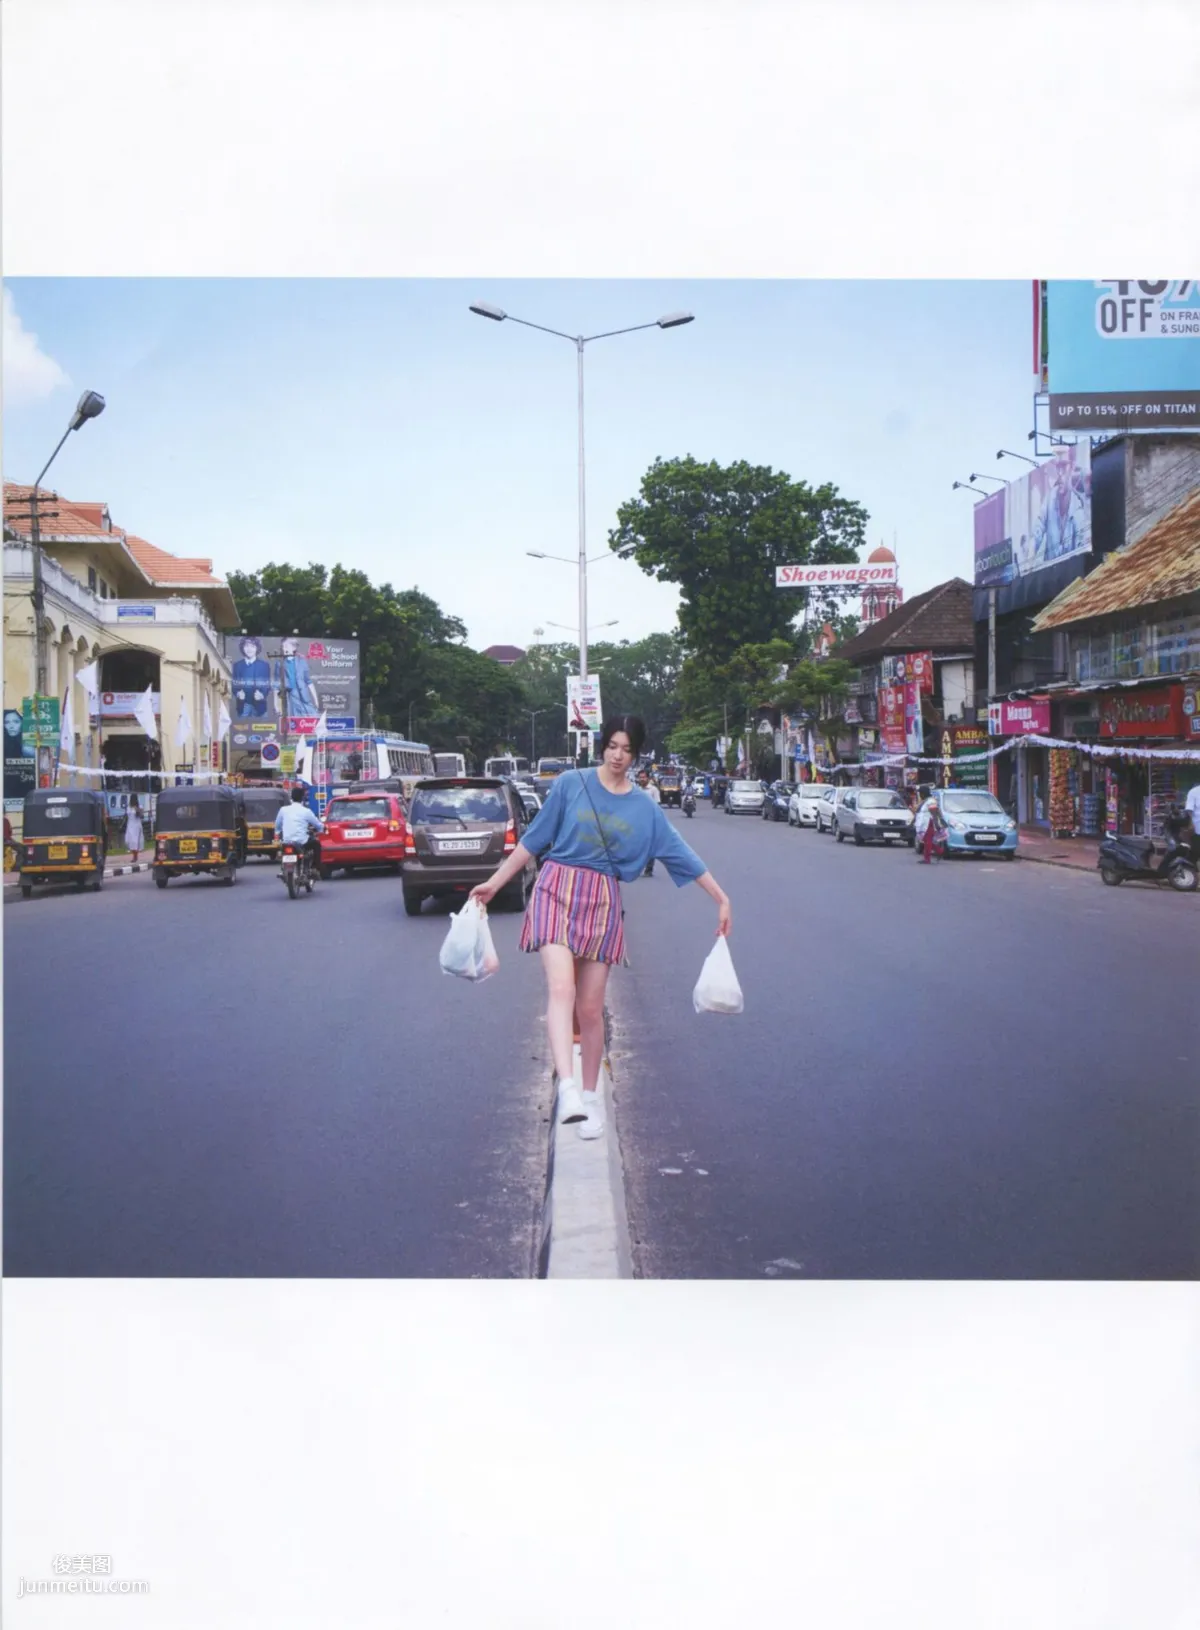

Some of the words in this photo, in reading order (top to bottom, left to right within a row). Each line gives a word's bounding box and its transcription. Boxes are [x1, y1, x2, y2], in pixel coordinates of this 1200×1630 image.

[1101, 298, 1154, 333] OFF
[1160, 311, 1175, 321] ON
[1058, 406, 1074, 416] UP
[1077, 405, 1091, 415] TO
[1095, 405, 1117, 415] 15%
[1120, 404, 1142, 415] OFF
[1145, 404, 1160, 414] ON
[1164, 404, 1196, 414] TITAN
[778, 566, 894, 583] Shoewagon
[321, 660, 353, 668] Uniform
